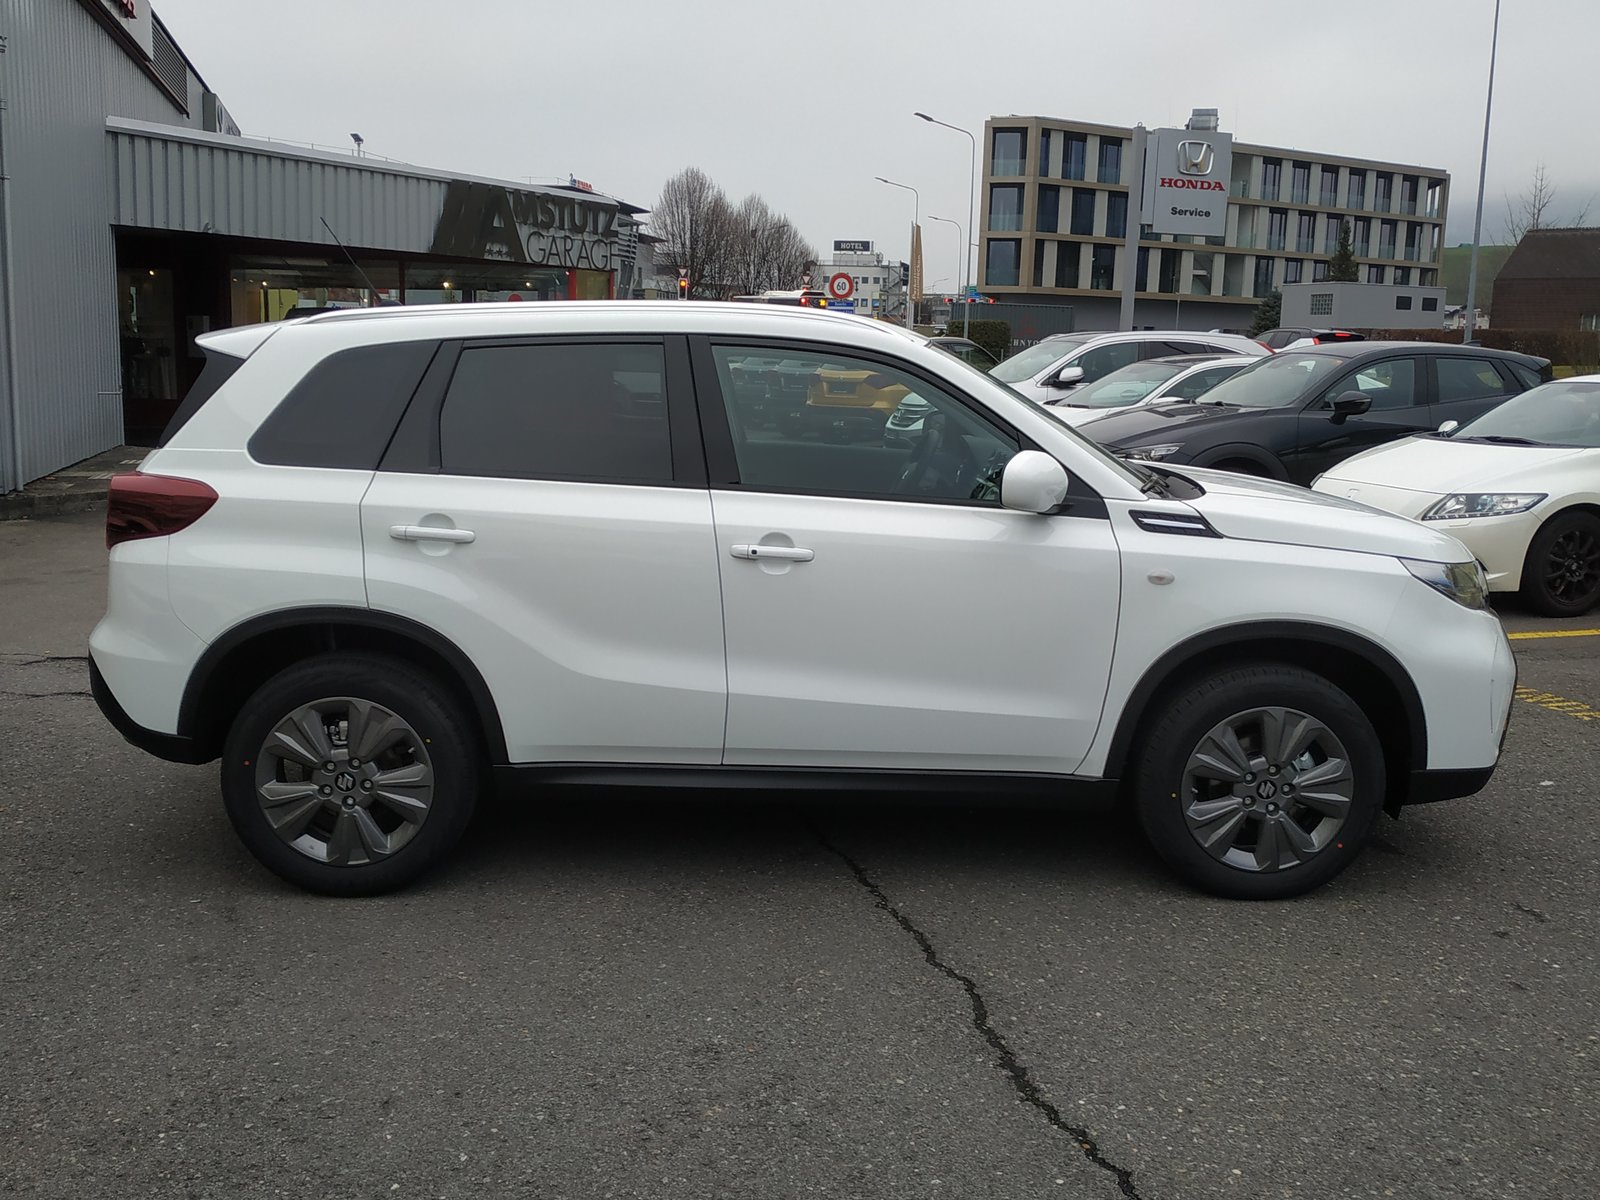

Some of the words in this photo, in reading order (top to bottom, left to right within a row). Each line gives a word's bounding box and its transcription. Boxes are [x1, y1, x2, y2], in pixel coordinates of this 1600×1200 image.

[1160, 178, 1225, 191] HONDA
[1171, 207, 1211, 217] Service
[474, 181, 619, 263] AMSTUTZ
[526, 231, 619, 272] GARAGE
[840, 242, 864, 250] HOTEL
[836, 282, 847, 291] 60
